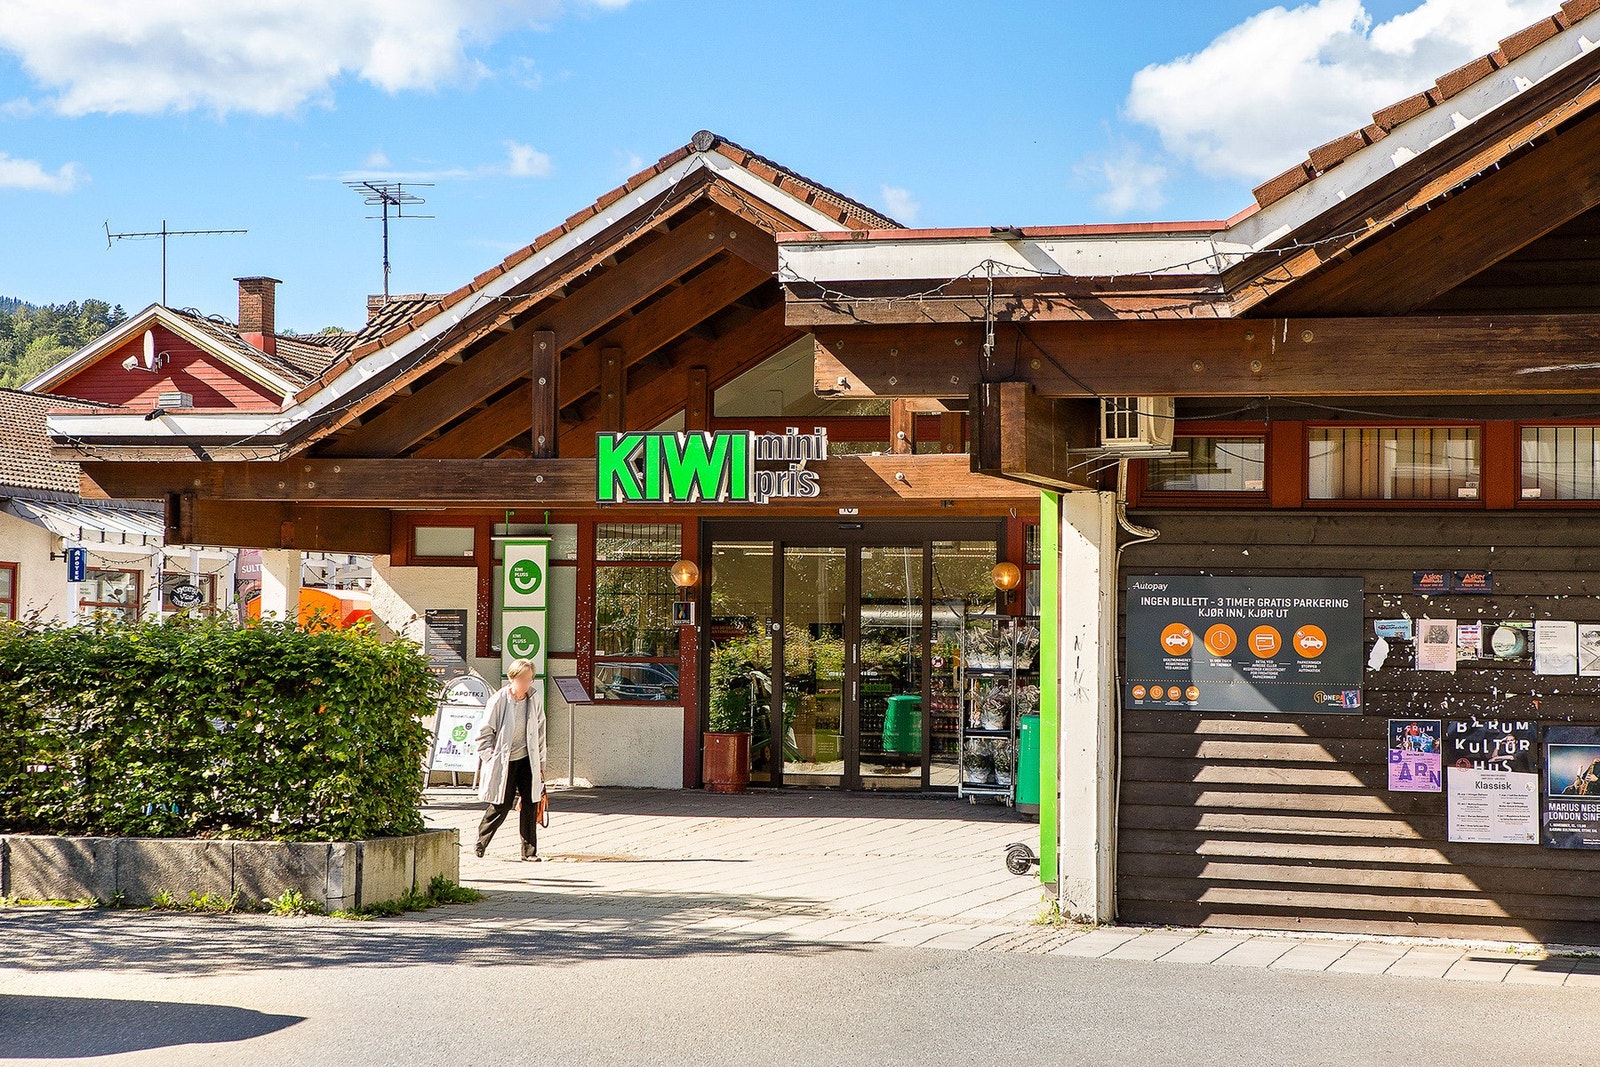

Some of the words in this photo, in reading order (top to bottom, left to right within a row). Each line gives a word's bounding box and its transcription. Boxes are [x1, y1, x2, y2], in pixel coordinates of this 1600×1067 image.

[756, 427, 827, 460] mini
[596, 430, 752, 503] KIWI
[755, 463, 820, 503] pris
[241, 563, 262, 574] SULT
[1421, 573, 1443, 582] Asker
[1462, 573, 1486, 582] Asker
[1132, 582, 1168, 591] Autopay
[1140, 596, 1170, 606] INGEN
[1171, 597, 1209, 607] BILLETT
[1217, 598, 1224, 607] 3
[1227, 598, 1255, 607] TIMER
[1257, 598, 1291, 607] GRATIS
[1293, 599, 1349, 608] PARKERING
[1198, 608, 1224, 618] KJØR
[1226, 609, 1246, 618] INN,
[1248, 609, 1274, 618] KJØR
[1275, 609, 1289, 618] UT
[1455, 738, 1530, 753] KULTUR
[1473, 760, 1513, 773] HUS
[1475, 780, 1512, 790] Klassisk
[1548, 803, 1580, 812] MARIUS
[1549, 812, 1581, 820] LONDON
